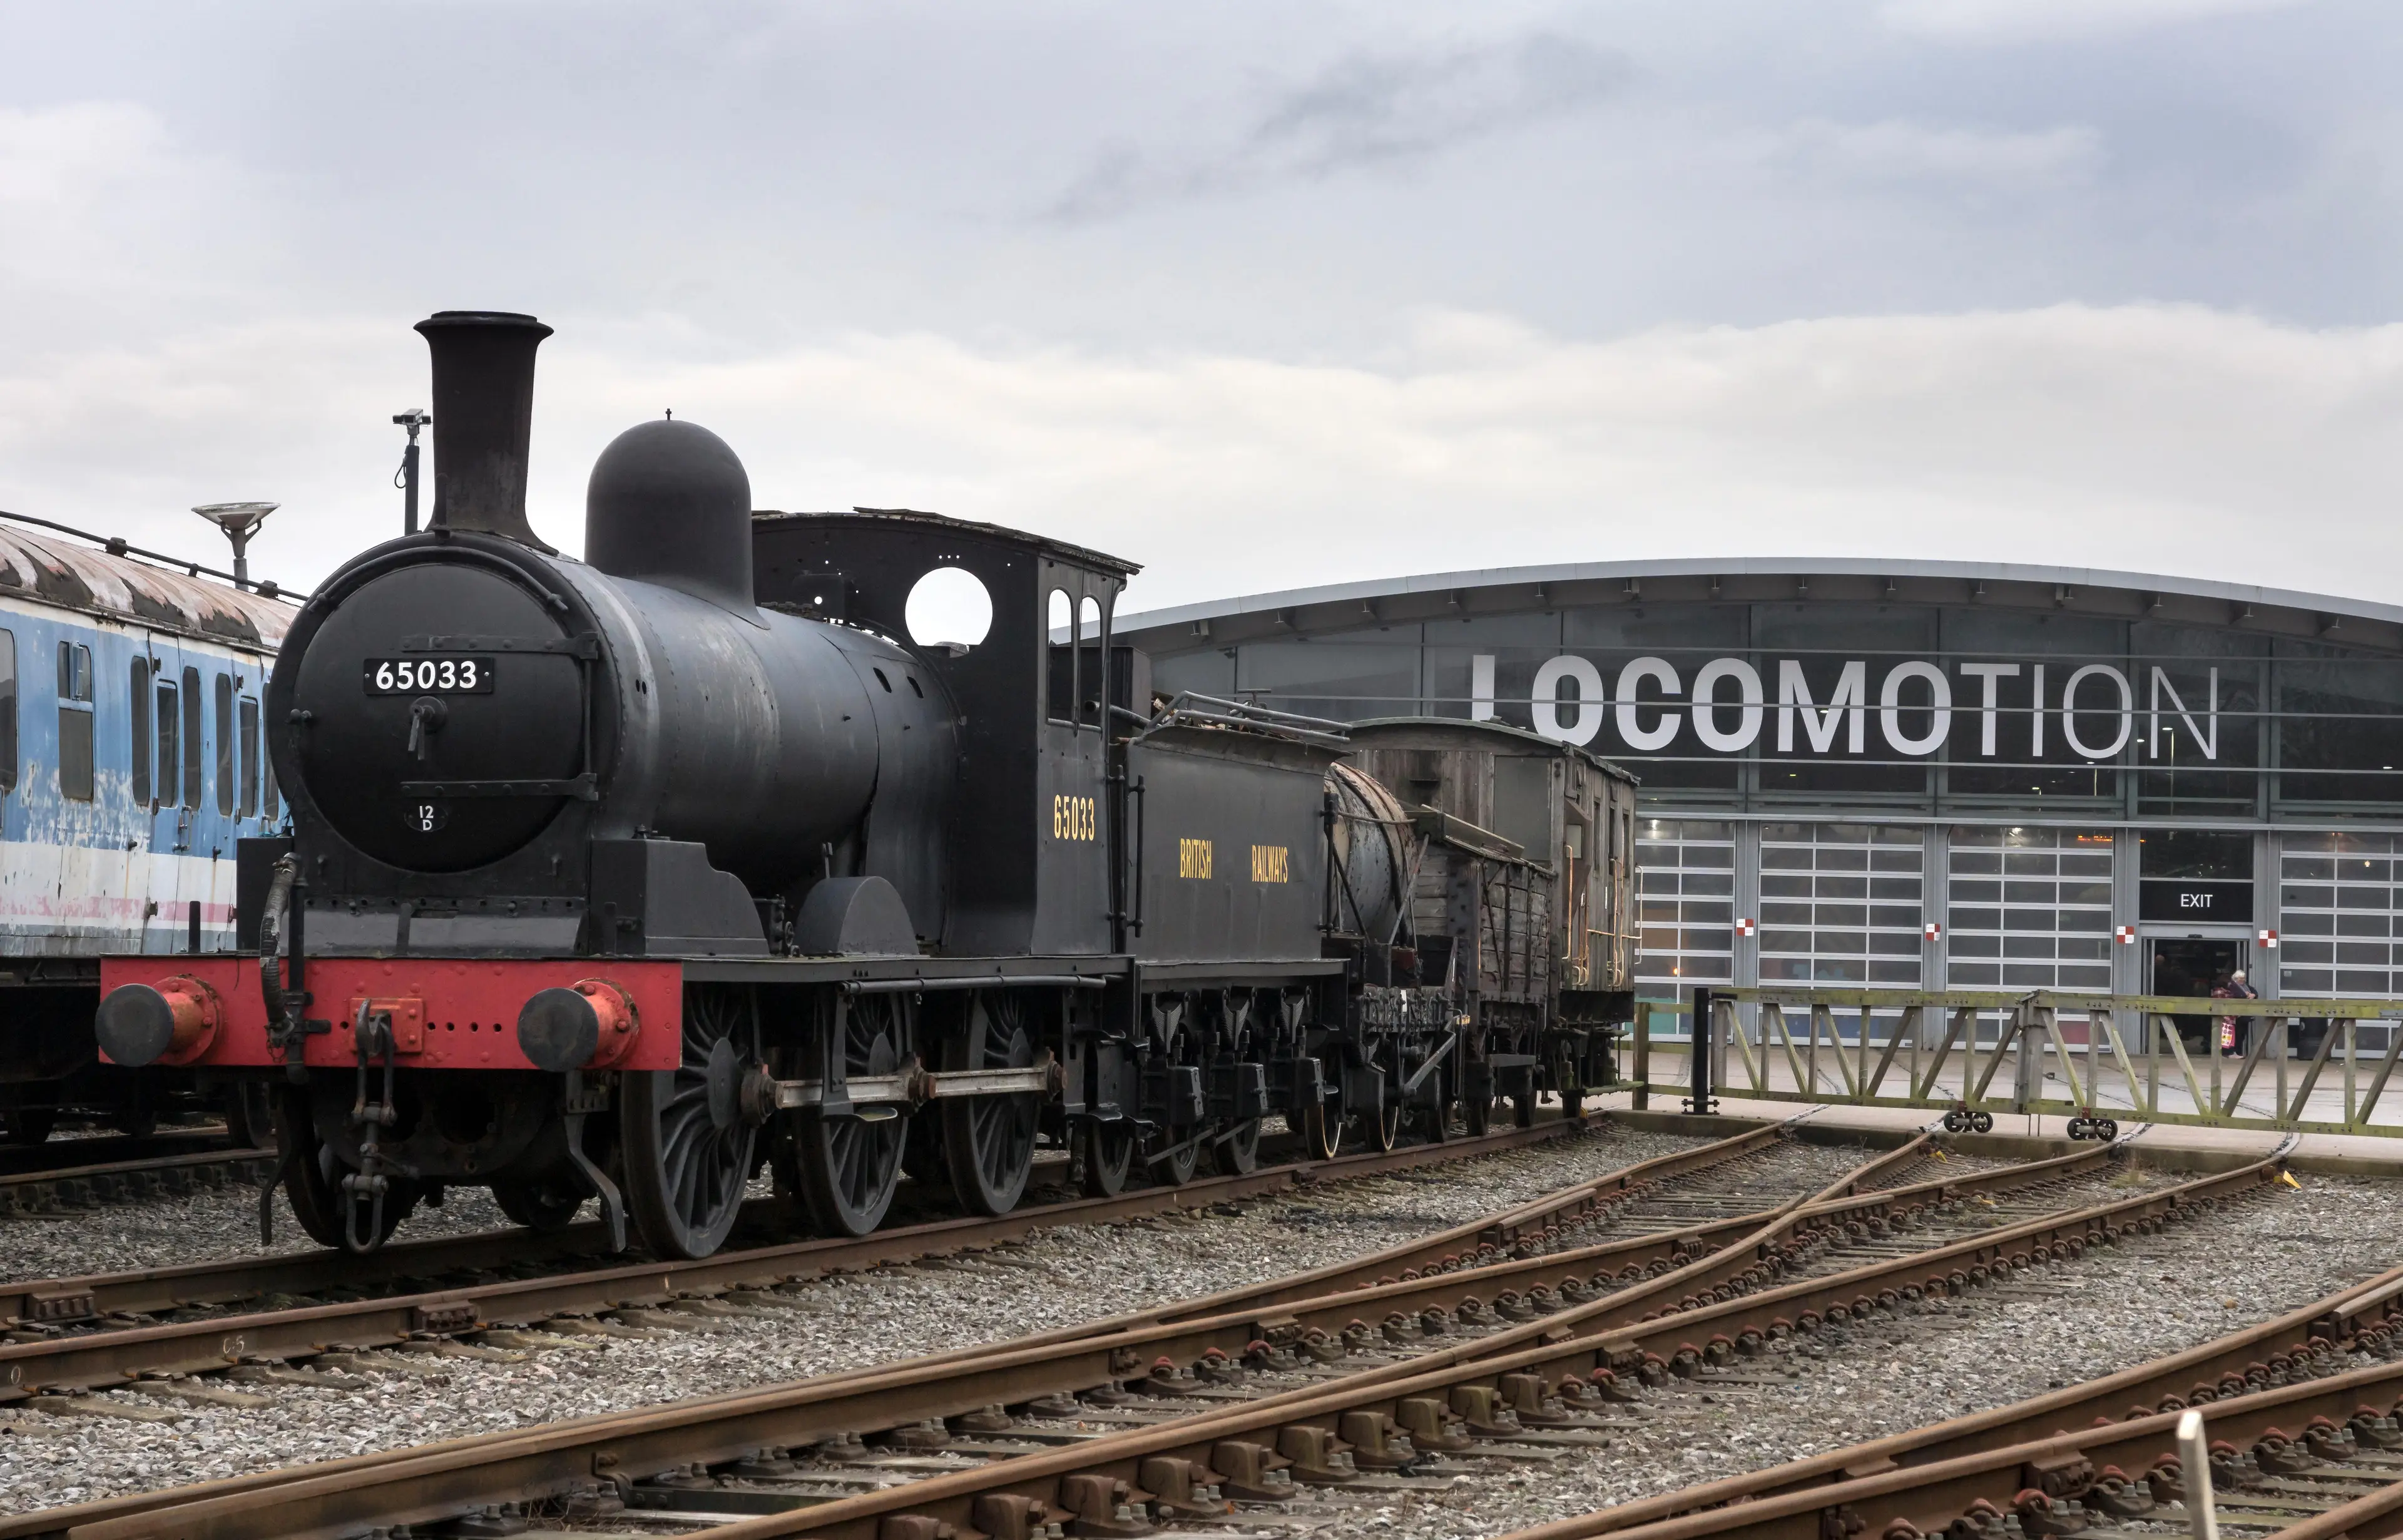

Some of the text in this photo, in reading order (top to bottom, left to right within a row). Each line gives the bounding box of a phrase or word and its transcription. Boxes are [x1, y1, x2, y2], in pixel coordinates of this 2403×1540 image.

[375, 661, 477, 690] 65033
[1472, 655, 2217, 760] LOCOMOTION
[419, 805, 434, 818] 12
[422, 819, 432, 831] D
[1054, 794, 1095, 841] 65033
[1180, 838, 1288, 884] BRITISH RAILWAYS
[2180, 894, 2213, 908] EXIT
